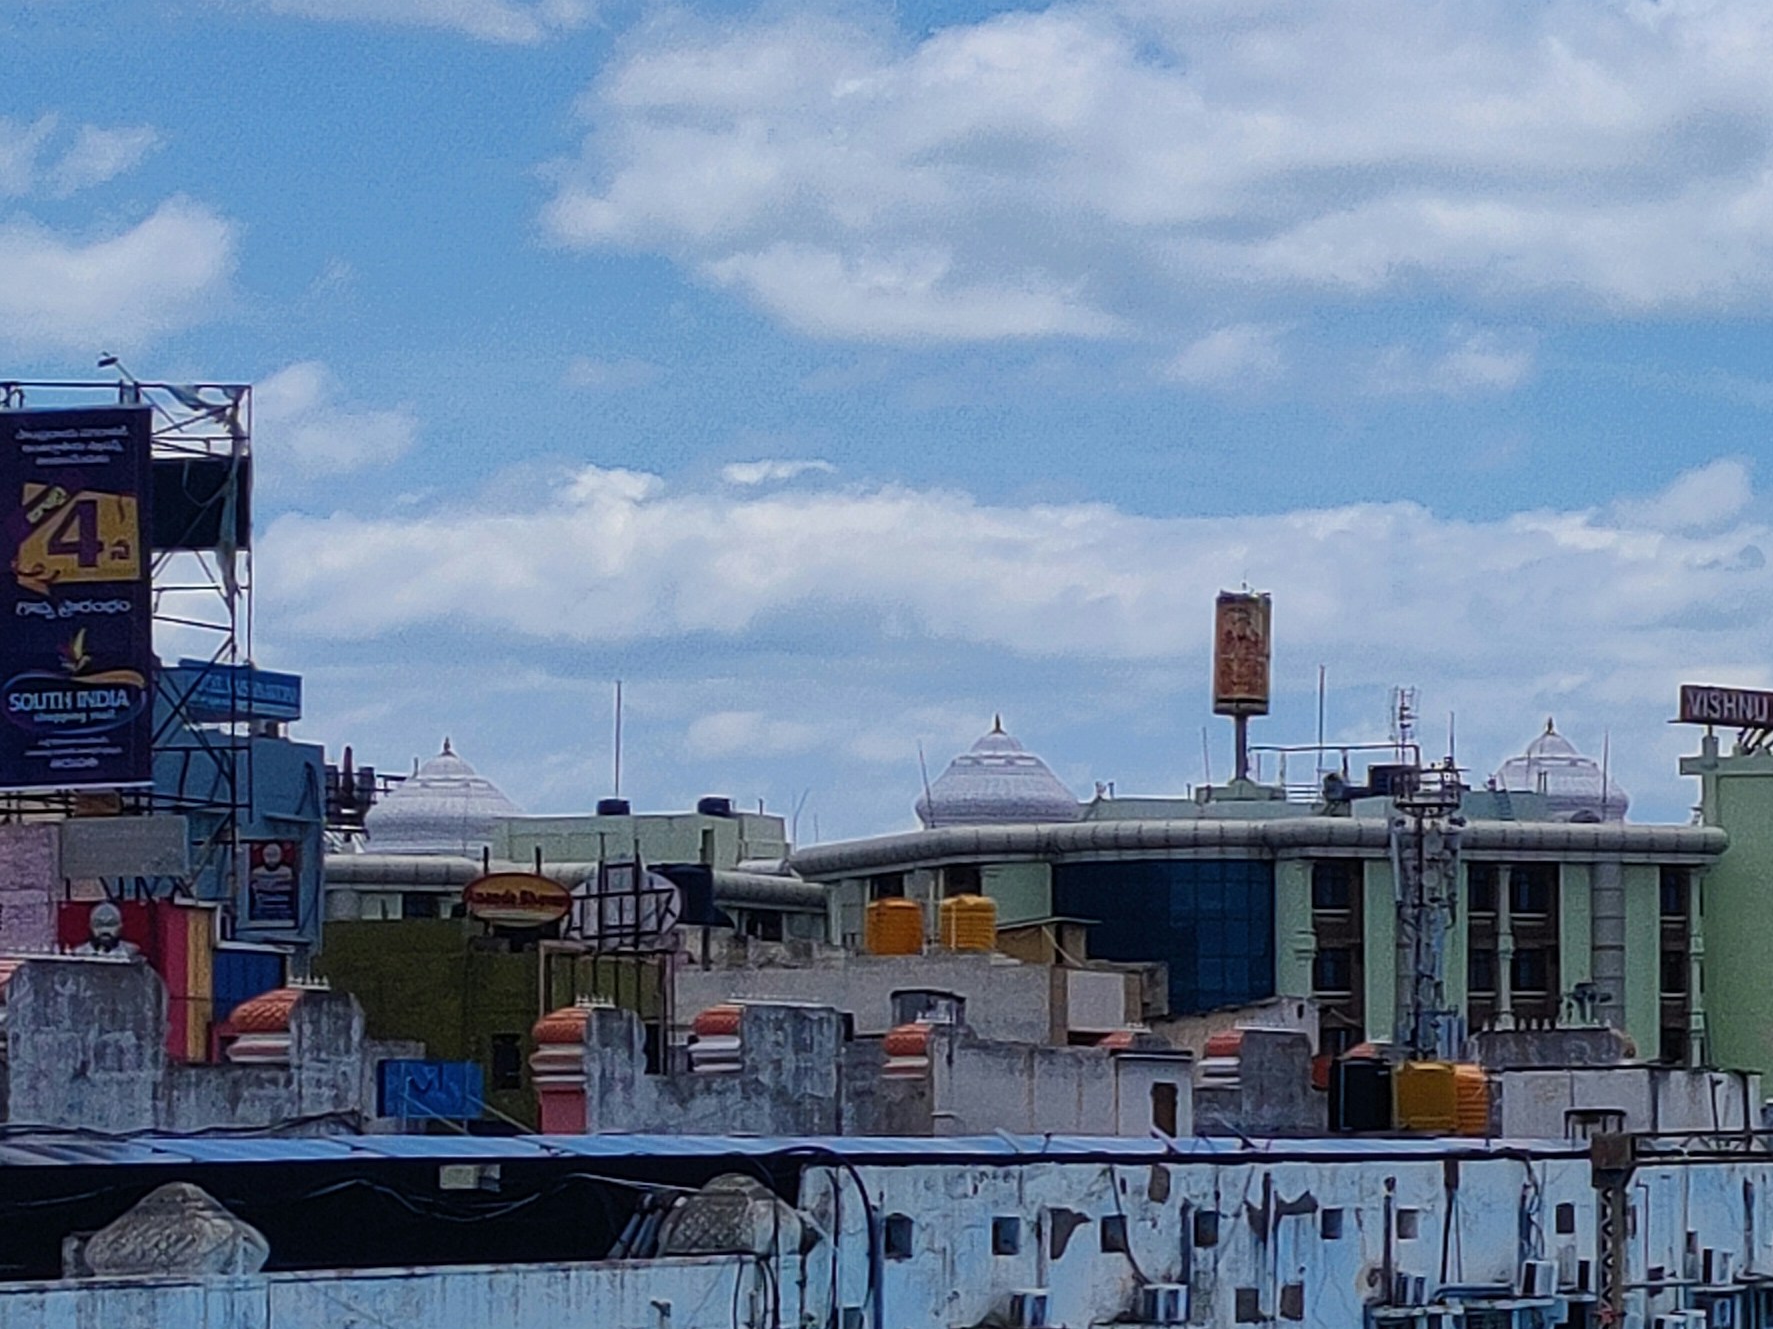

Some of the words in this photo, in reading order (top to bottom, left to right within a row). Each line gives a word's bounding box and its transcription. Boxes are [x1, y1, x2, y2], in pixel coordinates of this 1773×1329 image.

[48, 499, 104, 568] 4
[8, 691, 73, 712] SOUTH
[76, 688, 131, 709] INDIA
[1688, 688, 1768, 721] VISHNU
